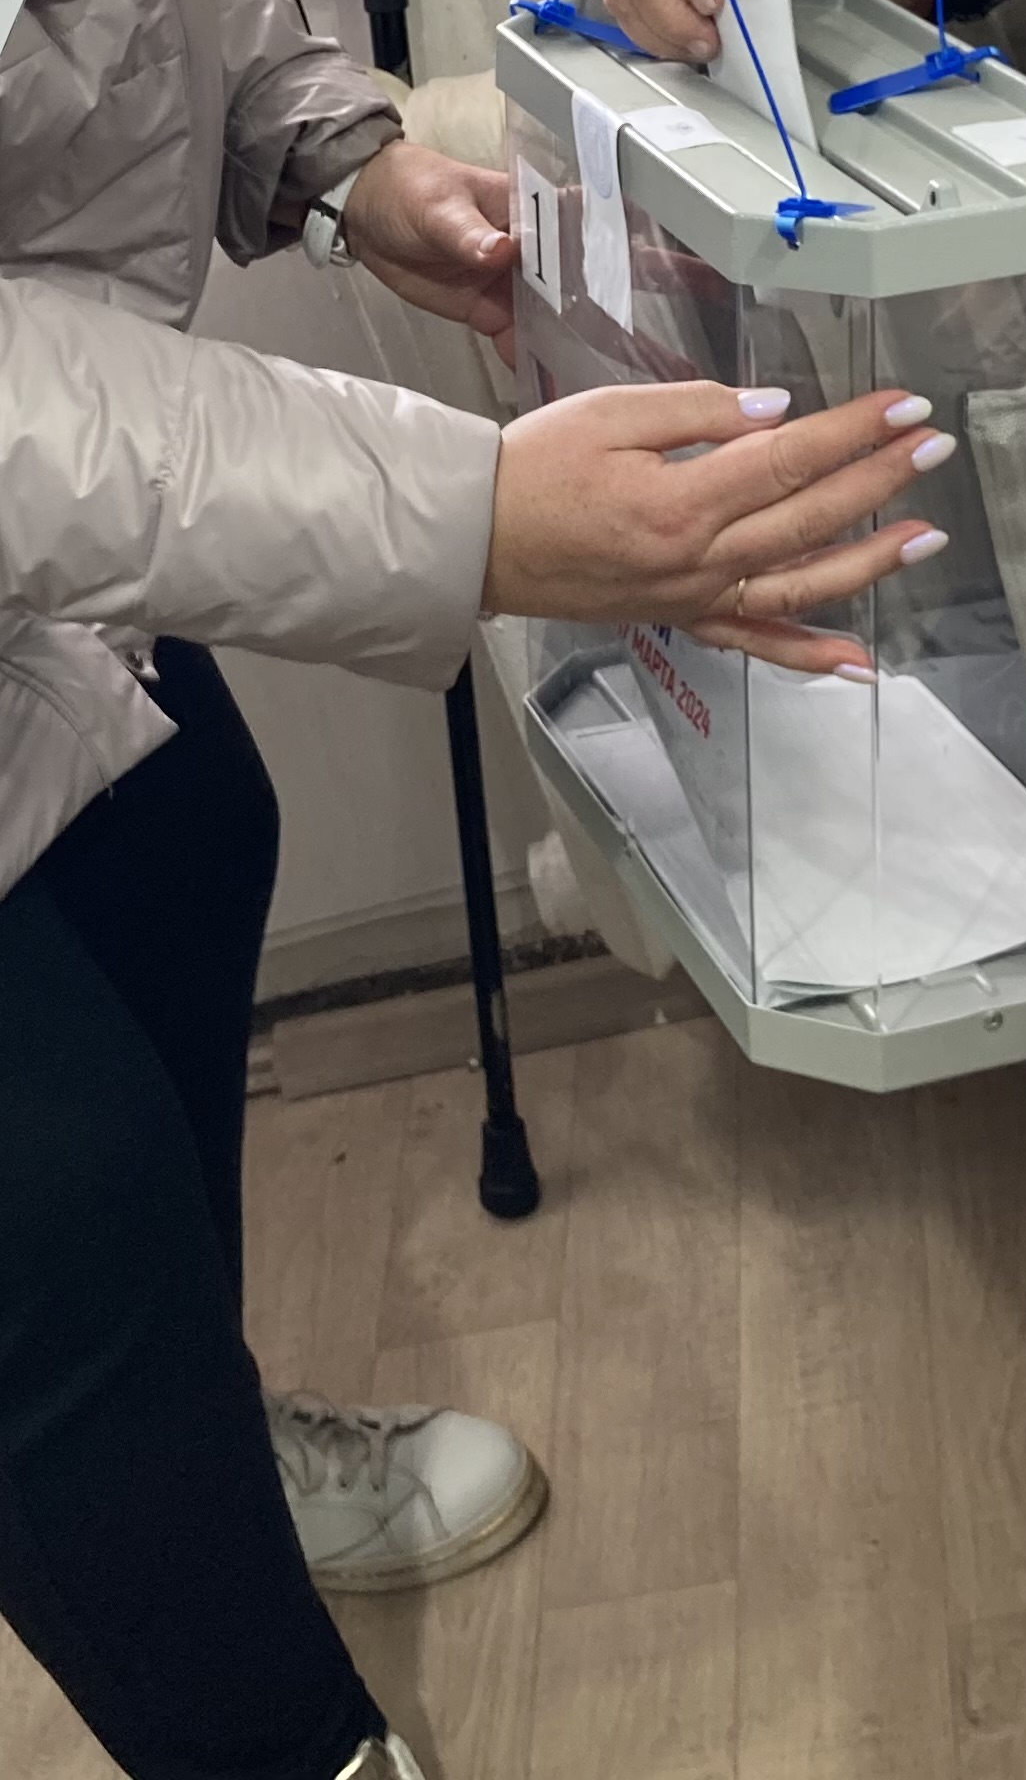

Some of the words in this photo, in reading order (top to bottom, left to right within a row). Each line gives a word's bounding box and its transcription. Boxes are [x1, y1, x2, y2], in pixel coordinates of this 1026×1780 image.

[531, 191, 547, 285] 1
[632, 626, 676, 699] МАРТА
[676, 680, 711, 739] 2024
